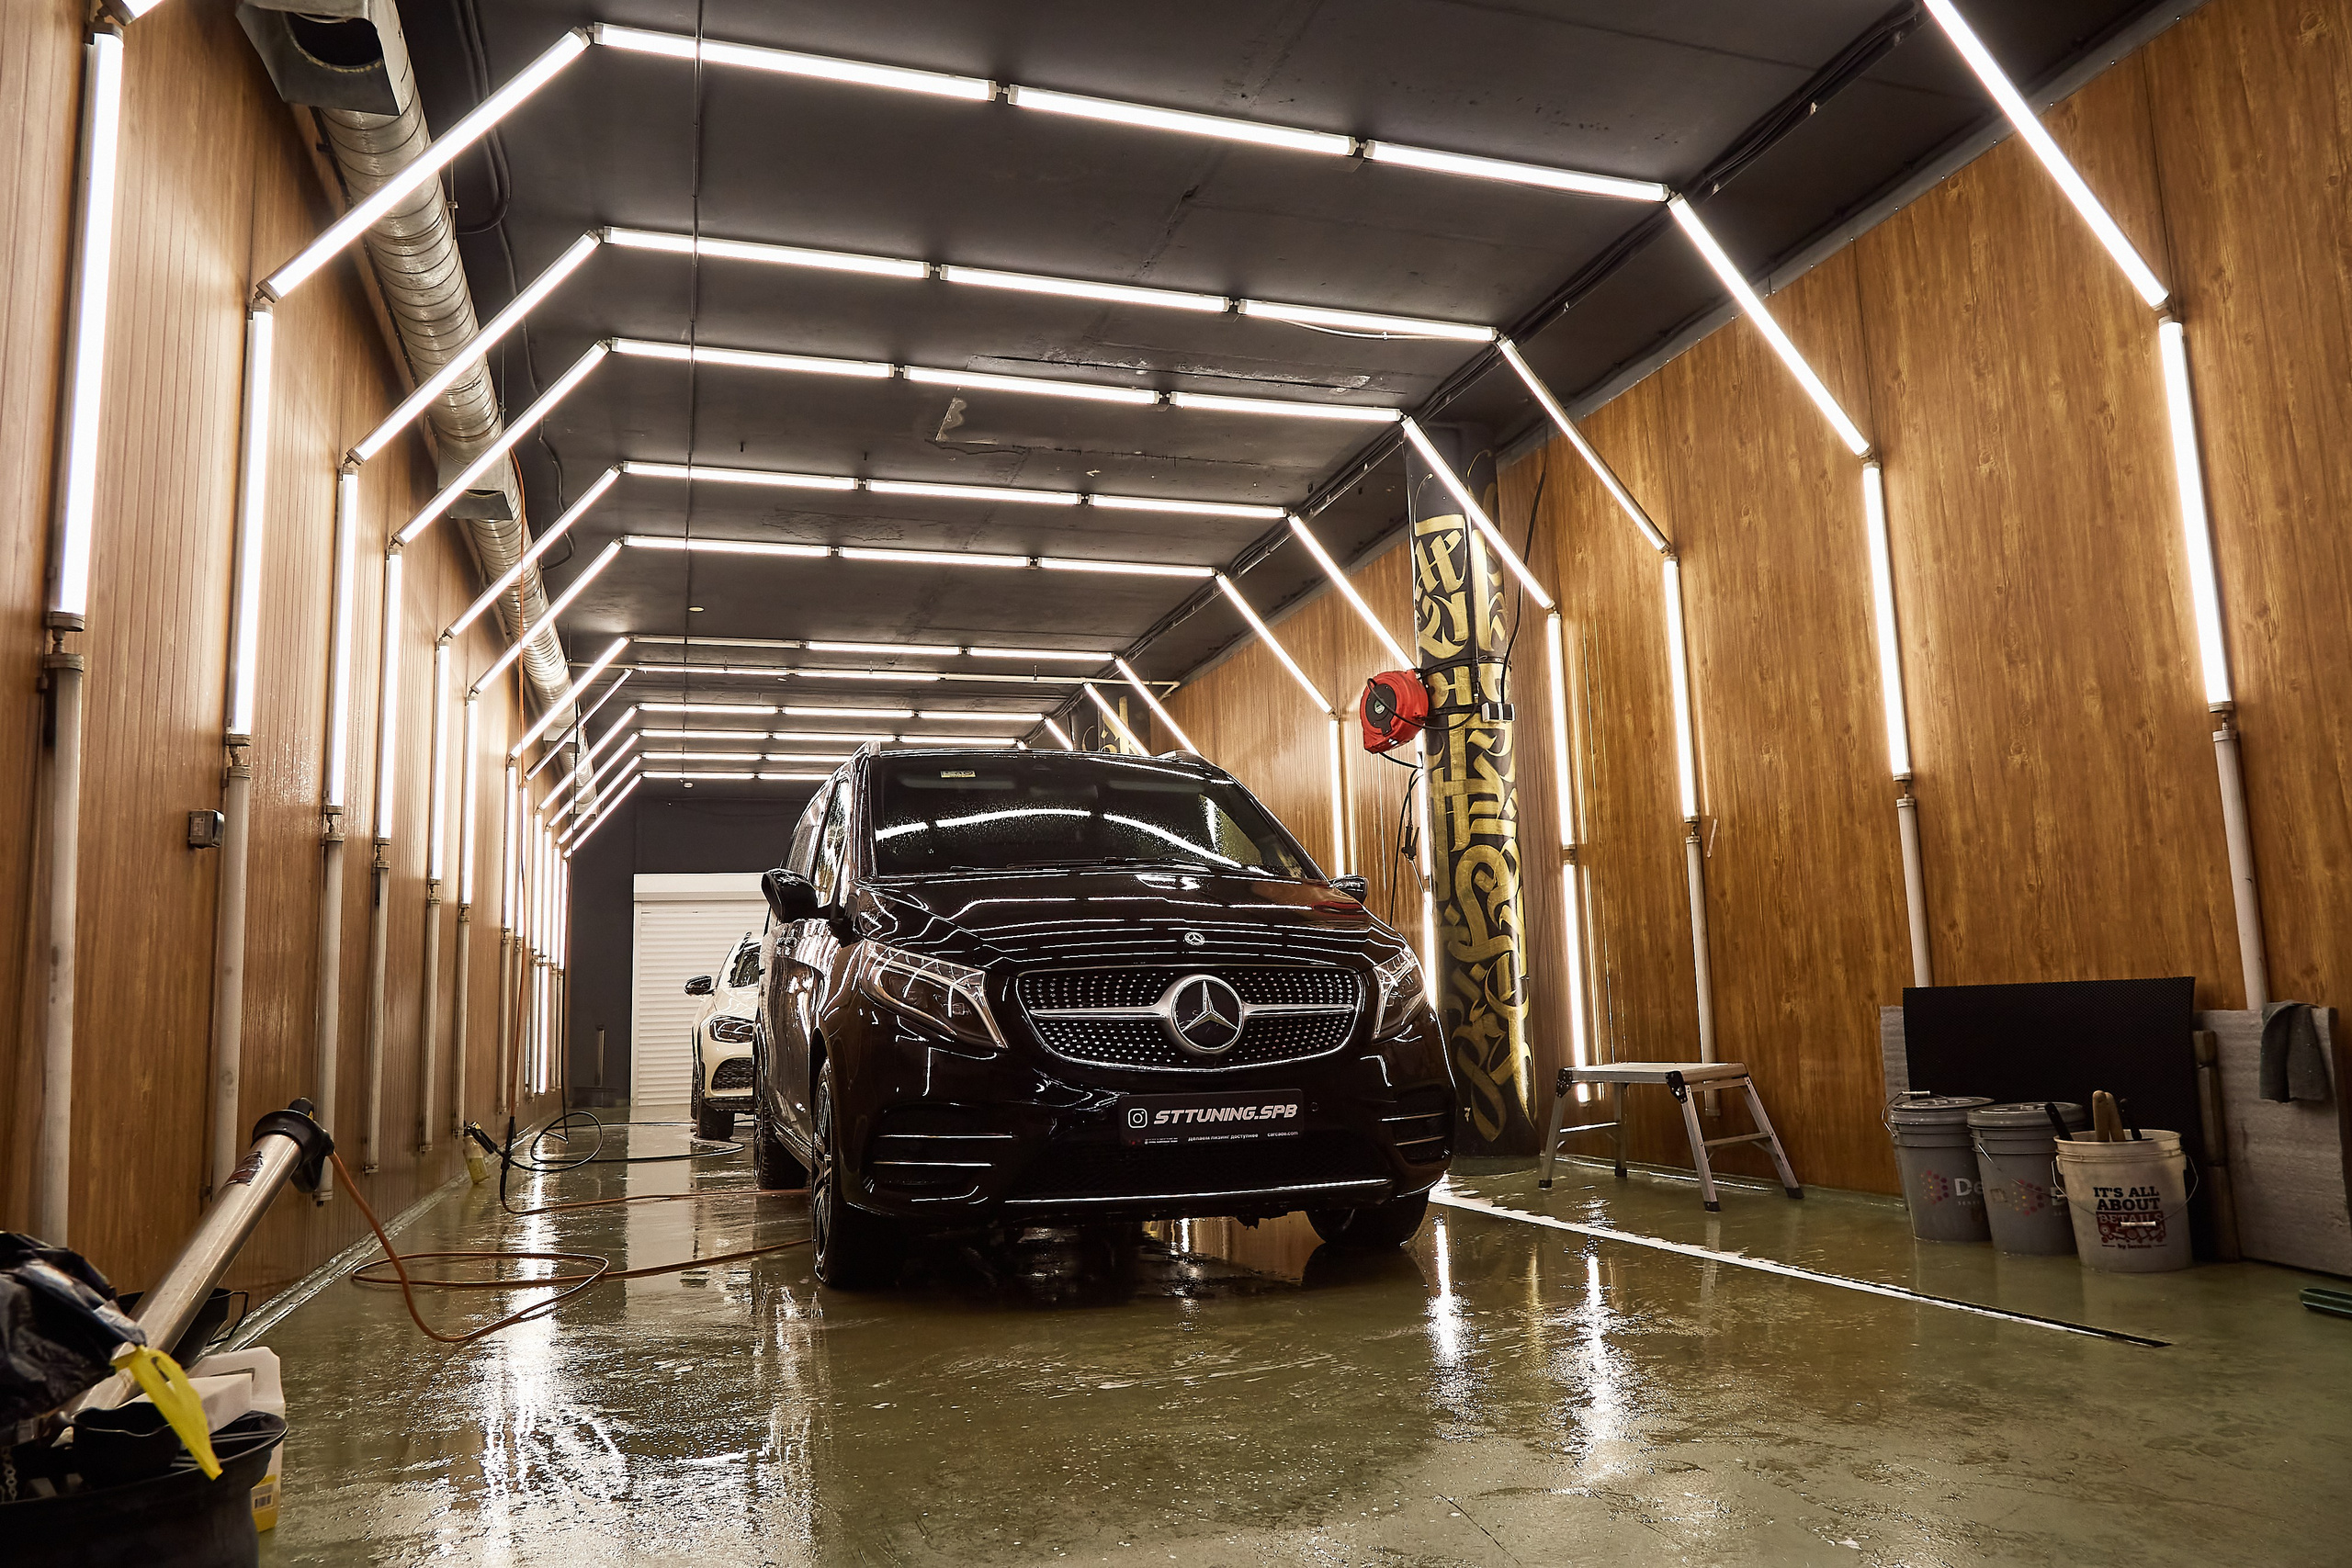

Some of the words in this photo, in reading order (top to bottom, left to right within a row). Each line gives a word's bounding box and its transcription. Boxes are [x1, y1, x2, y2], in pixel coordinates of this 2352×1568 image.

[1153, 1103, 1298, 1125] STTUNING.SPB
[2093, 1187, 2123, 1198] IT'S
[2128, 1186, 2160, 1198] ALL
[2097, 1198, 2160, 1211] ABOUT
